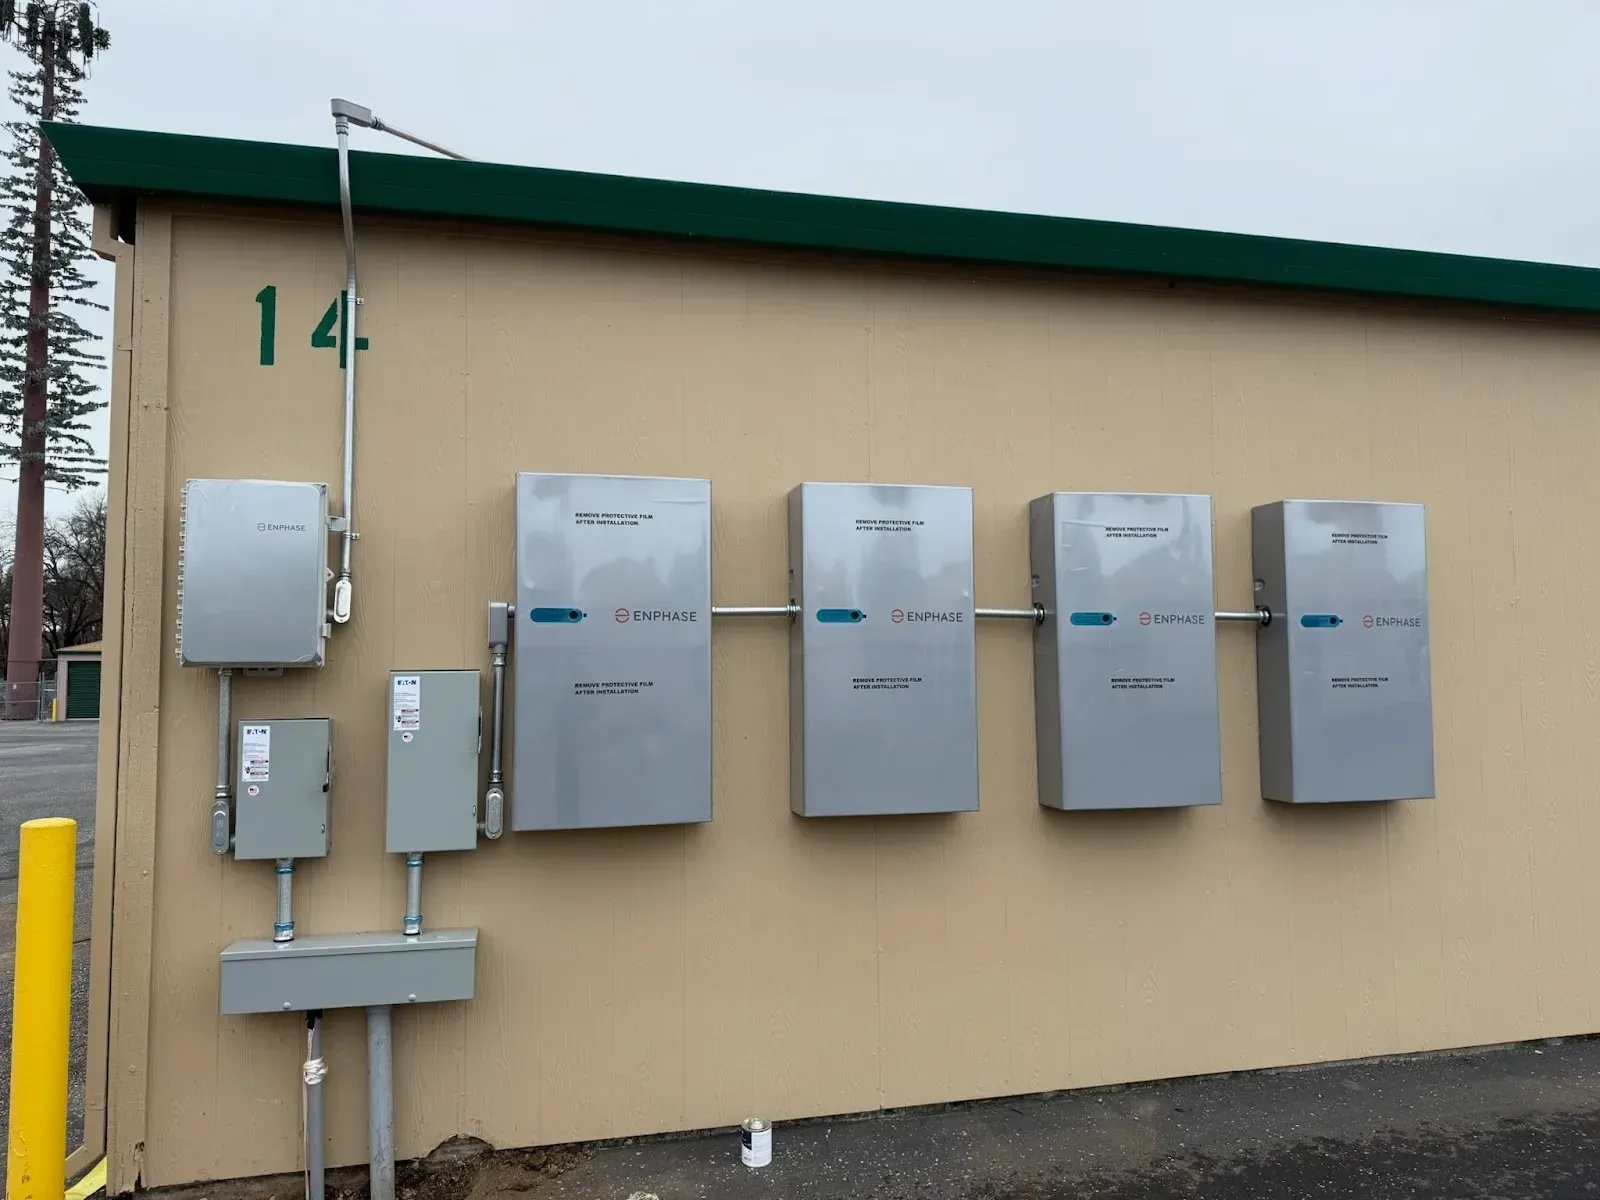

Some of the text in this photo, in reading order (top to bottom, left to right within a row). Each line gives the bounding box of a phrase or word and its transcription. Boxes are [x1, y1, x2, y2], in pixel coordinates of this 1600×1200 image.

[267, 524, 306, 532] ENPHASE
[633, 610, 698, 622] ENPHASE
[907, 611, 963, 622] ENPHASE
[1154, 614, 1205, 624] ENPHASE
[1376, 616, 1421, 627] ENPHASE
